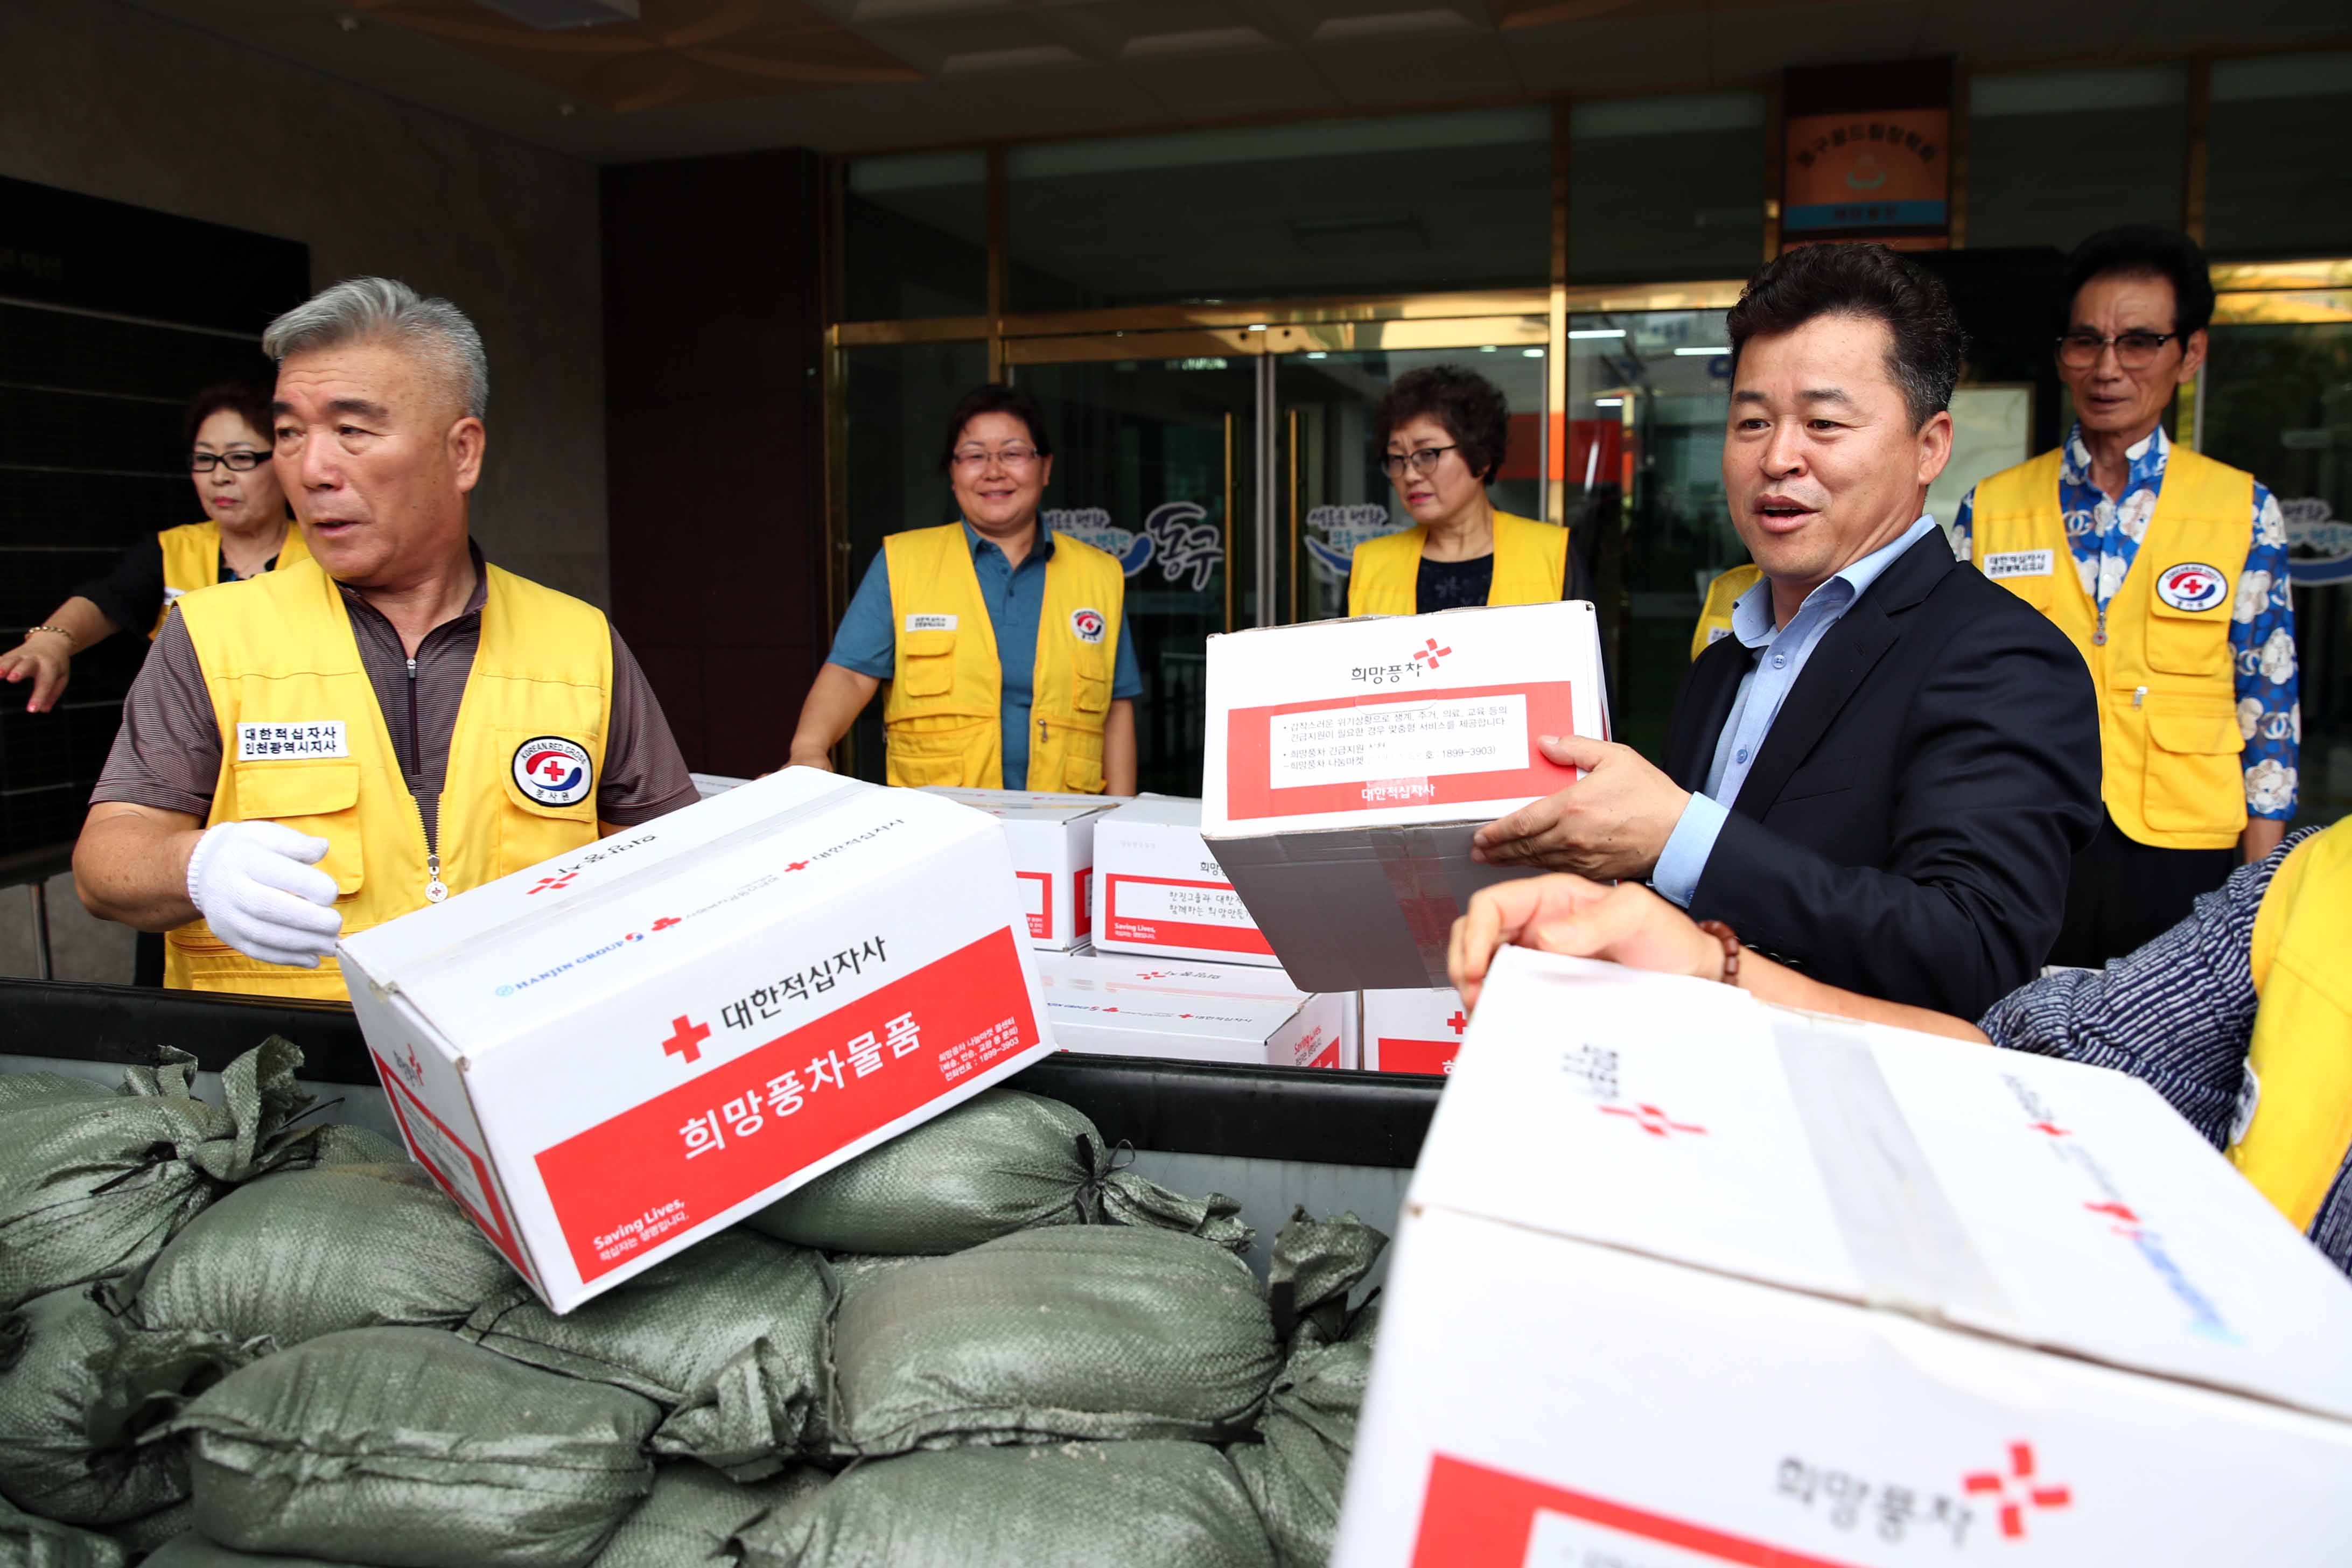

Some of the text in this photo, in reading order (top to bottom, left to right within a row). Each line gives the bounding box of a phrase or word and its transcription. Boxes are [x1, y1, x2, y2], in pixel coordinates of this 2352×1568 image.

[1149, 505, 1224, 589] 동구
[1351, 662, 1423, 684] 희망풍차
[1338, 714, 1389, 727] 위기상황으로
[1467, 707, 1485, 716] 교육
[1488, 706, 1507, 715] 등의
[245, 726, 336, 741] 대한적십자사
[1338, 729, 1364, 739] 필요한
[1368, 726, 1385, 736] 경우
[246, 740, 336, 755] 인천광역시지사
[549, 743, 563, 751] RED
[1329, 744, 1364, 755] 긴급지원
[1362, 783, 1435, 801] 대한적십자사
[515, 940, 624, 989] HANJIN GROUP
[720, 935, 887, 1030] 대한적십자사
[979, 1036, 1019, 1063] 1899-3903
[678, 1011, 921, 1160] 희망풍차물품
[593, 1199, 685, 1250] Saving Lives,
